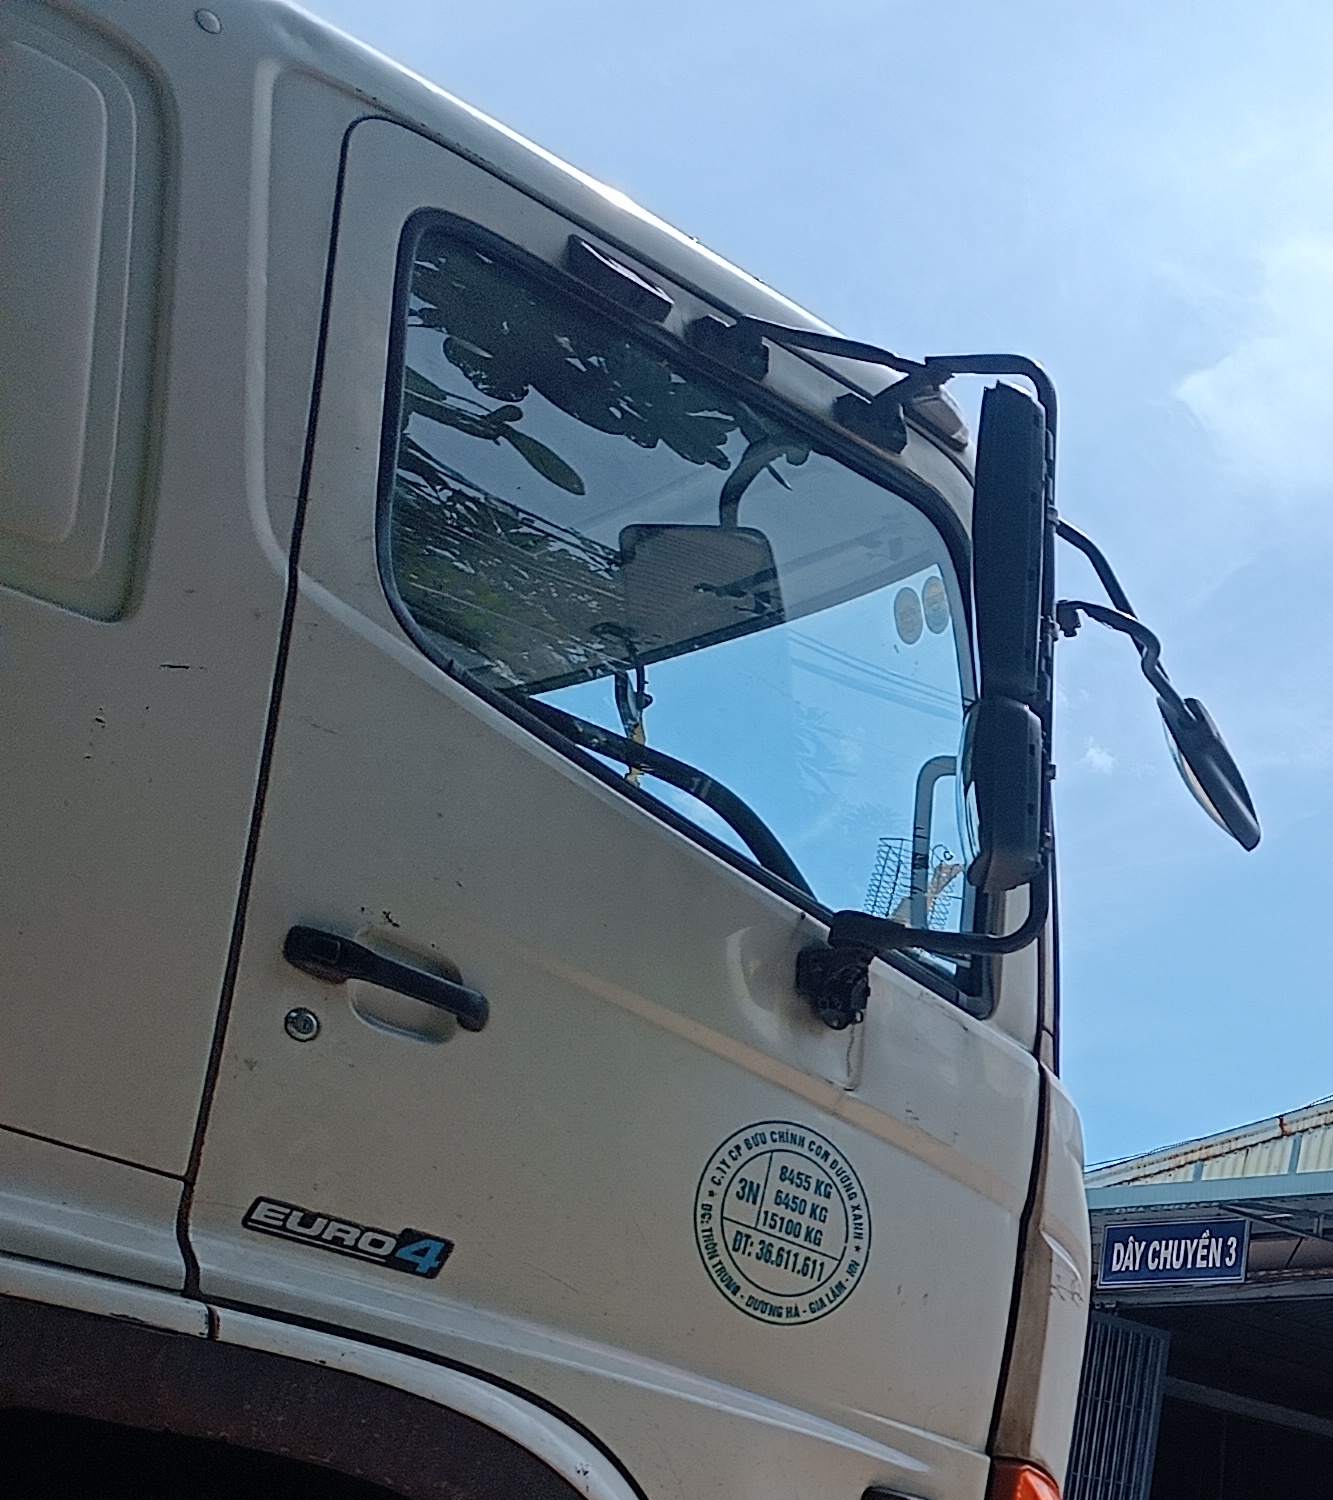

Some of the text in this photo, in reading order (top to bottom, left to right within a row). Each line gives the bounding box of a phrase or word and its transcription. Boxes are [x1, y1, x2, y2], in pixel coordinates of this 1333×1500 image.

[728, 1144, 742, 1161] CP
[770, 1128, 805, 1148] CHÍNH
[850, 1204, 864, 1240] XANH
[735, 1178, 760, 1206] 3N
[779, 1165, 833, 1200] 8455 KG
[774, 1189, 828, 1224] 6450 KG
[763, 1210, 823, 1247] 15100 KG
[732, 1230, 825, 1283] ĐT: 36.611.611
[1111, 1229, 1238, 1272] DÂY CHUYỀN 3
[808, 1297, 827, 1314] GIA
